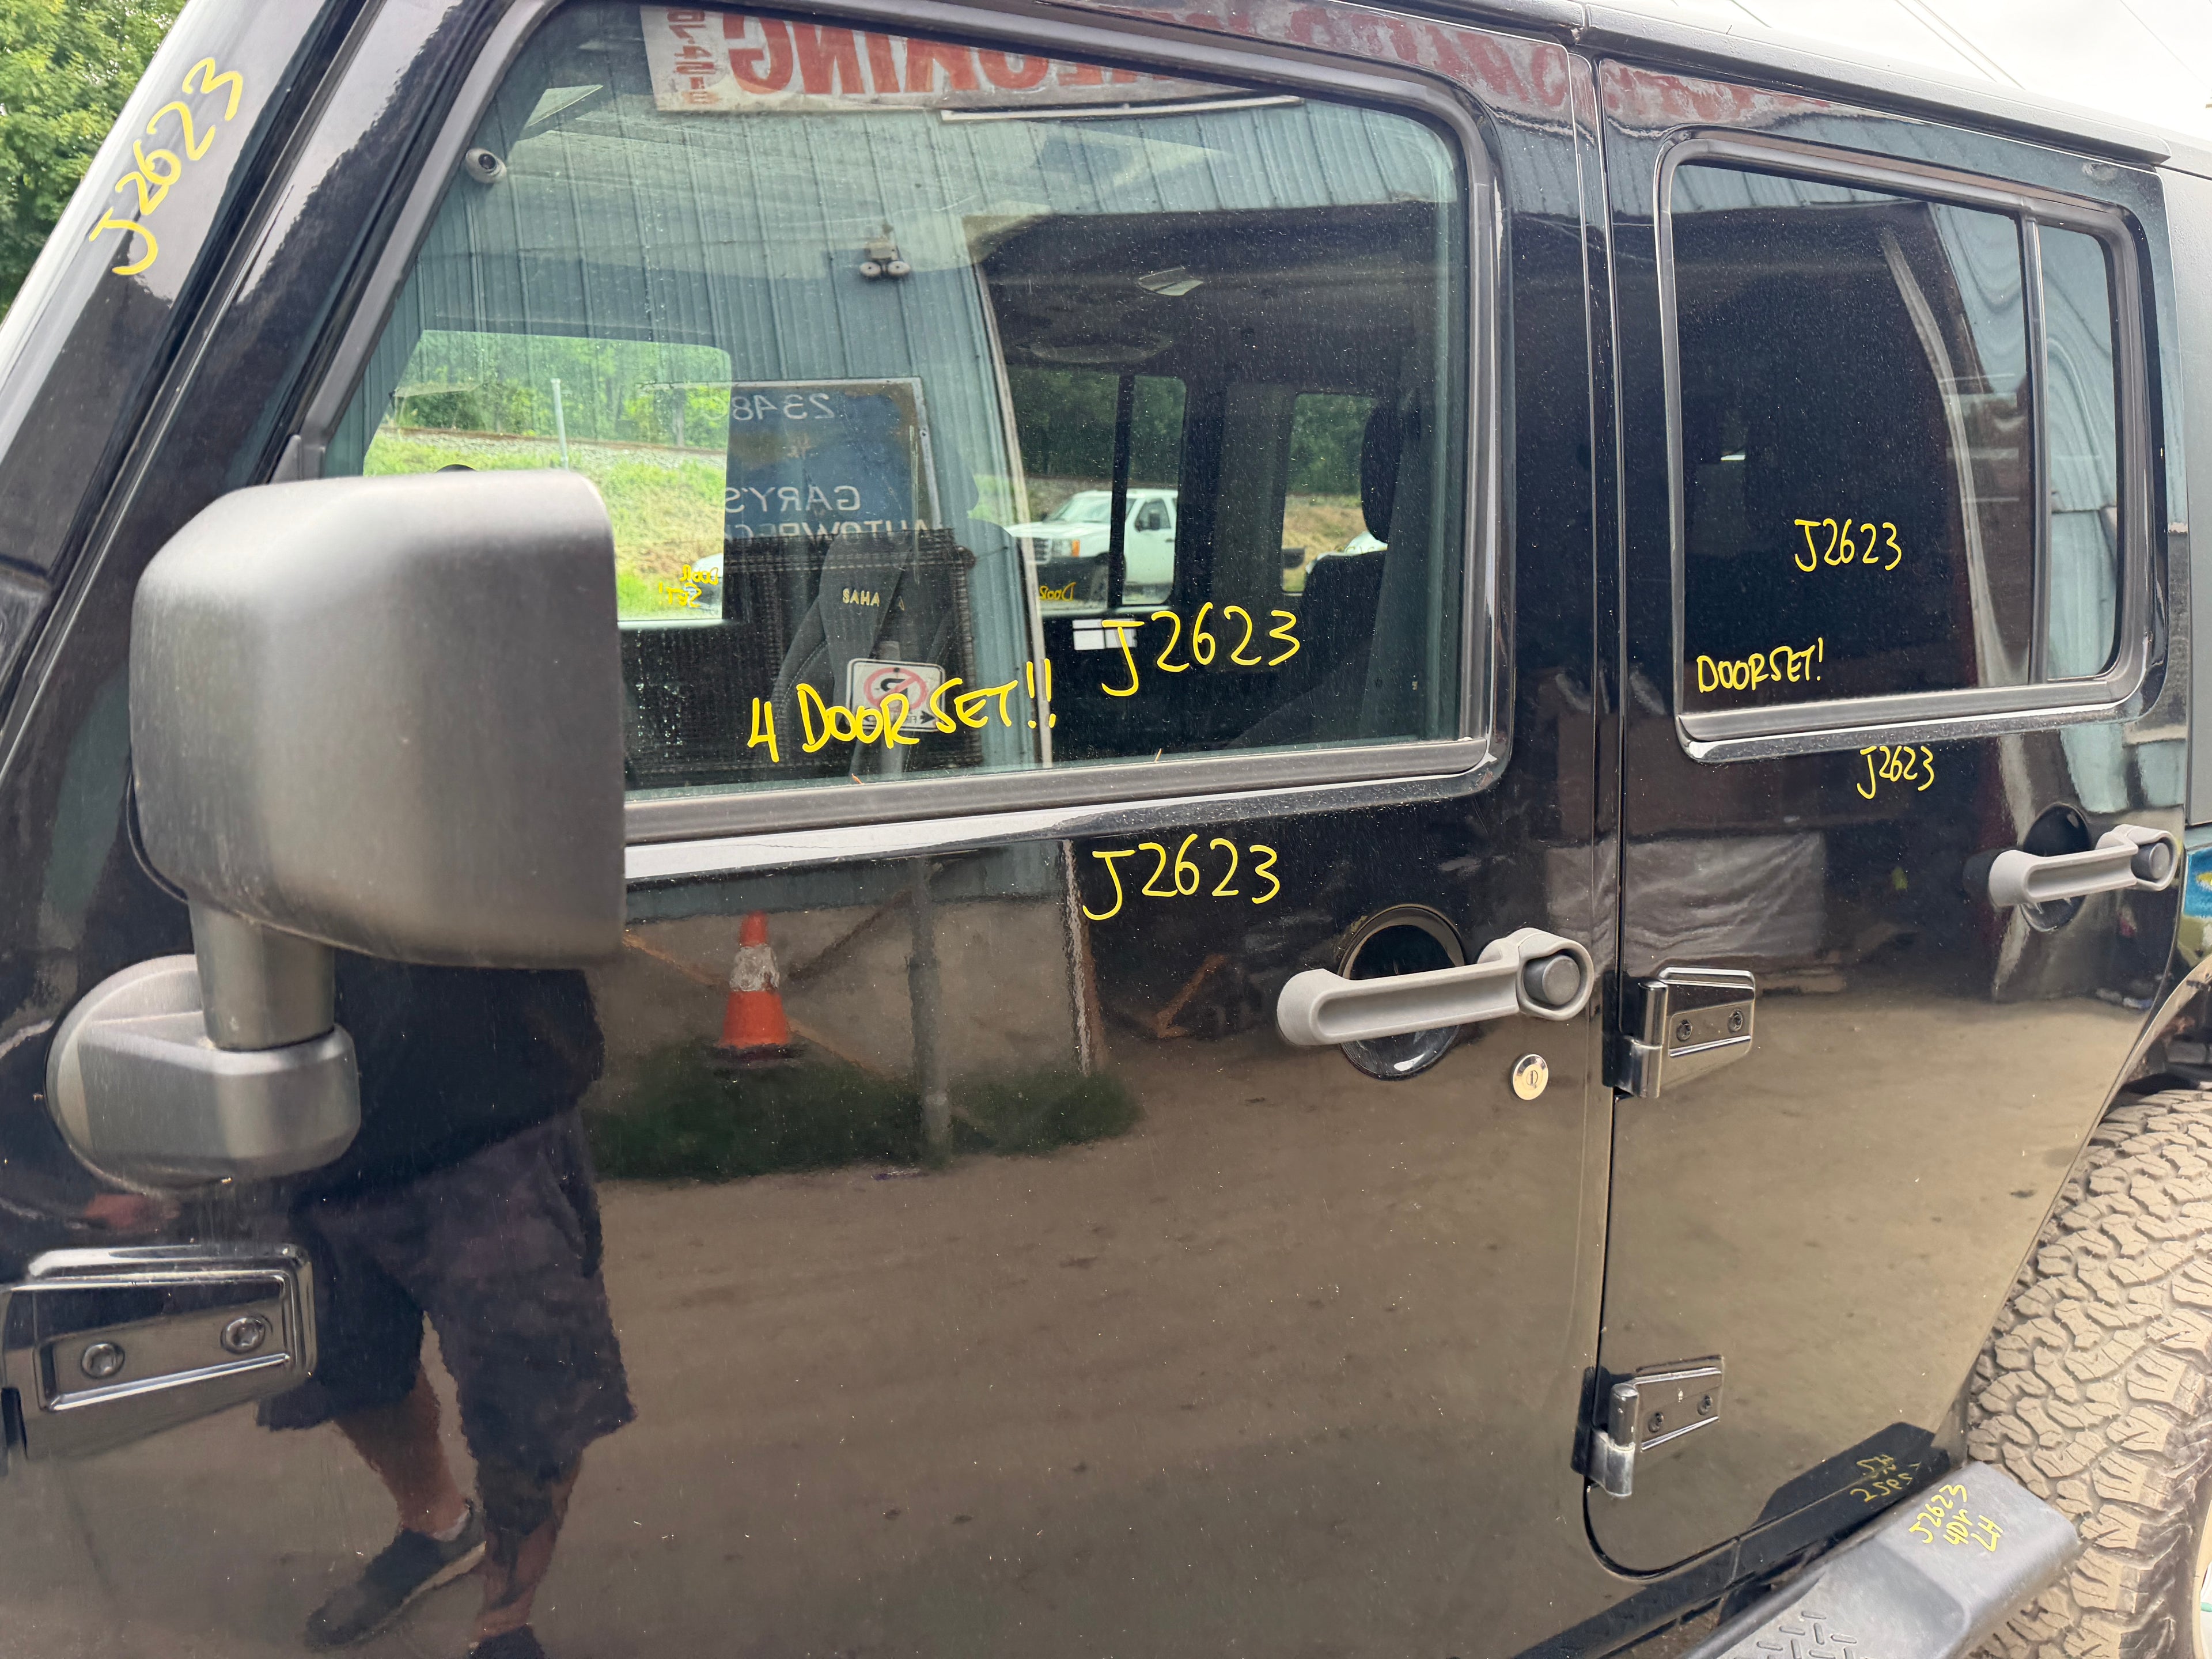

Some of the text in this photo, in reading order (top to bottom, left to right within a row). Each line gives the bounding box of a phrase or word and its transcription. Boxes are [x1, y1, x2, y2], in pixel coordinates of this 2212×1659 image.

[89, 57, 243, 275] J2623
[1794, 518, 1902, 572] J2623
[1101, 601, 1300, 696] J2623
[747, 697, 779, 763] 4
[796, 683, 920, 753] DOOR
[1857, 745, 1934, 800] J2623
[1082, 833, 1281, 921] J2623
[1908, 1484, 1967, 1544] J2623
